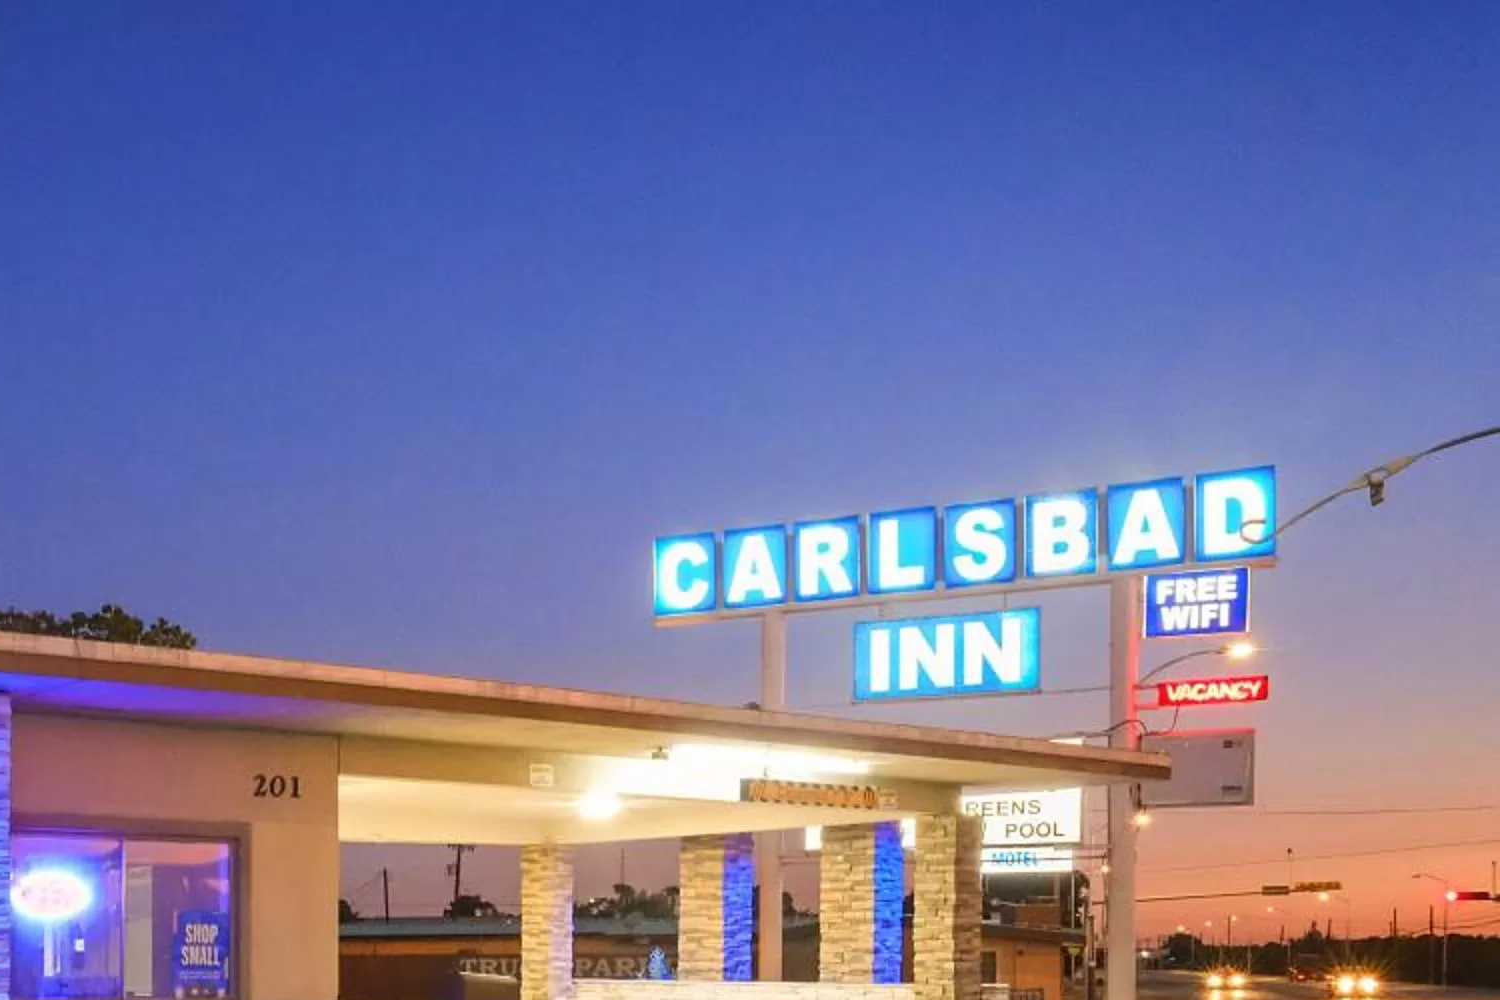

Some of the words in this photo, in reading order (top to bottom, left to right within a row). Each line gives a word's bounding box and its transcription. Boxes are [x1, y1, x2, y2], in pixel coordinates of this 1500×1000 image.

[657, 478, 1267, 610] CARLSBAD
[1155, 574, 1238, 605] FREE
[1160, 602, 1230, 631] WIFI
[869, 617, 1022, 692] INN
[1165, 680, 1262, 701] VACANCY
[252, 773, 304, 799] 201
[964, 799, 1042, 817] REENS
[1004, 820, 1067, 839] POOL
[184, 923, 219, 944] SHOP
[180, 945, 221, 968] SMALL
[459, 956, 522, 978] TRU
